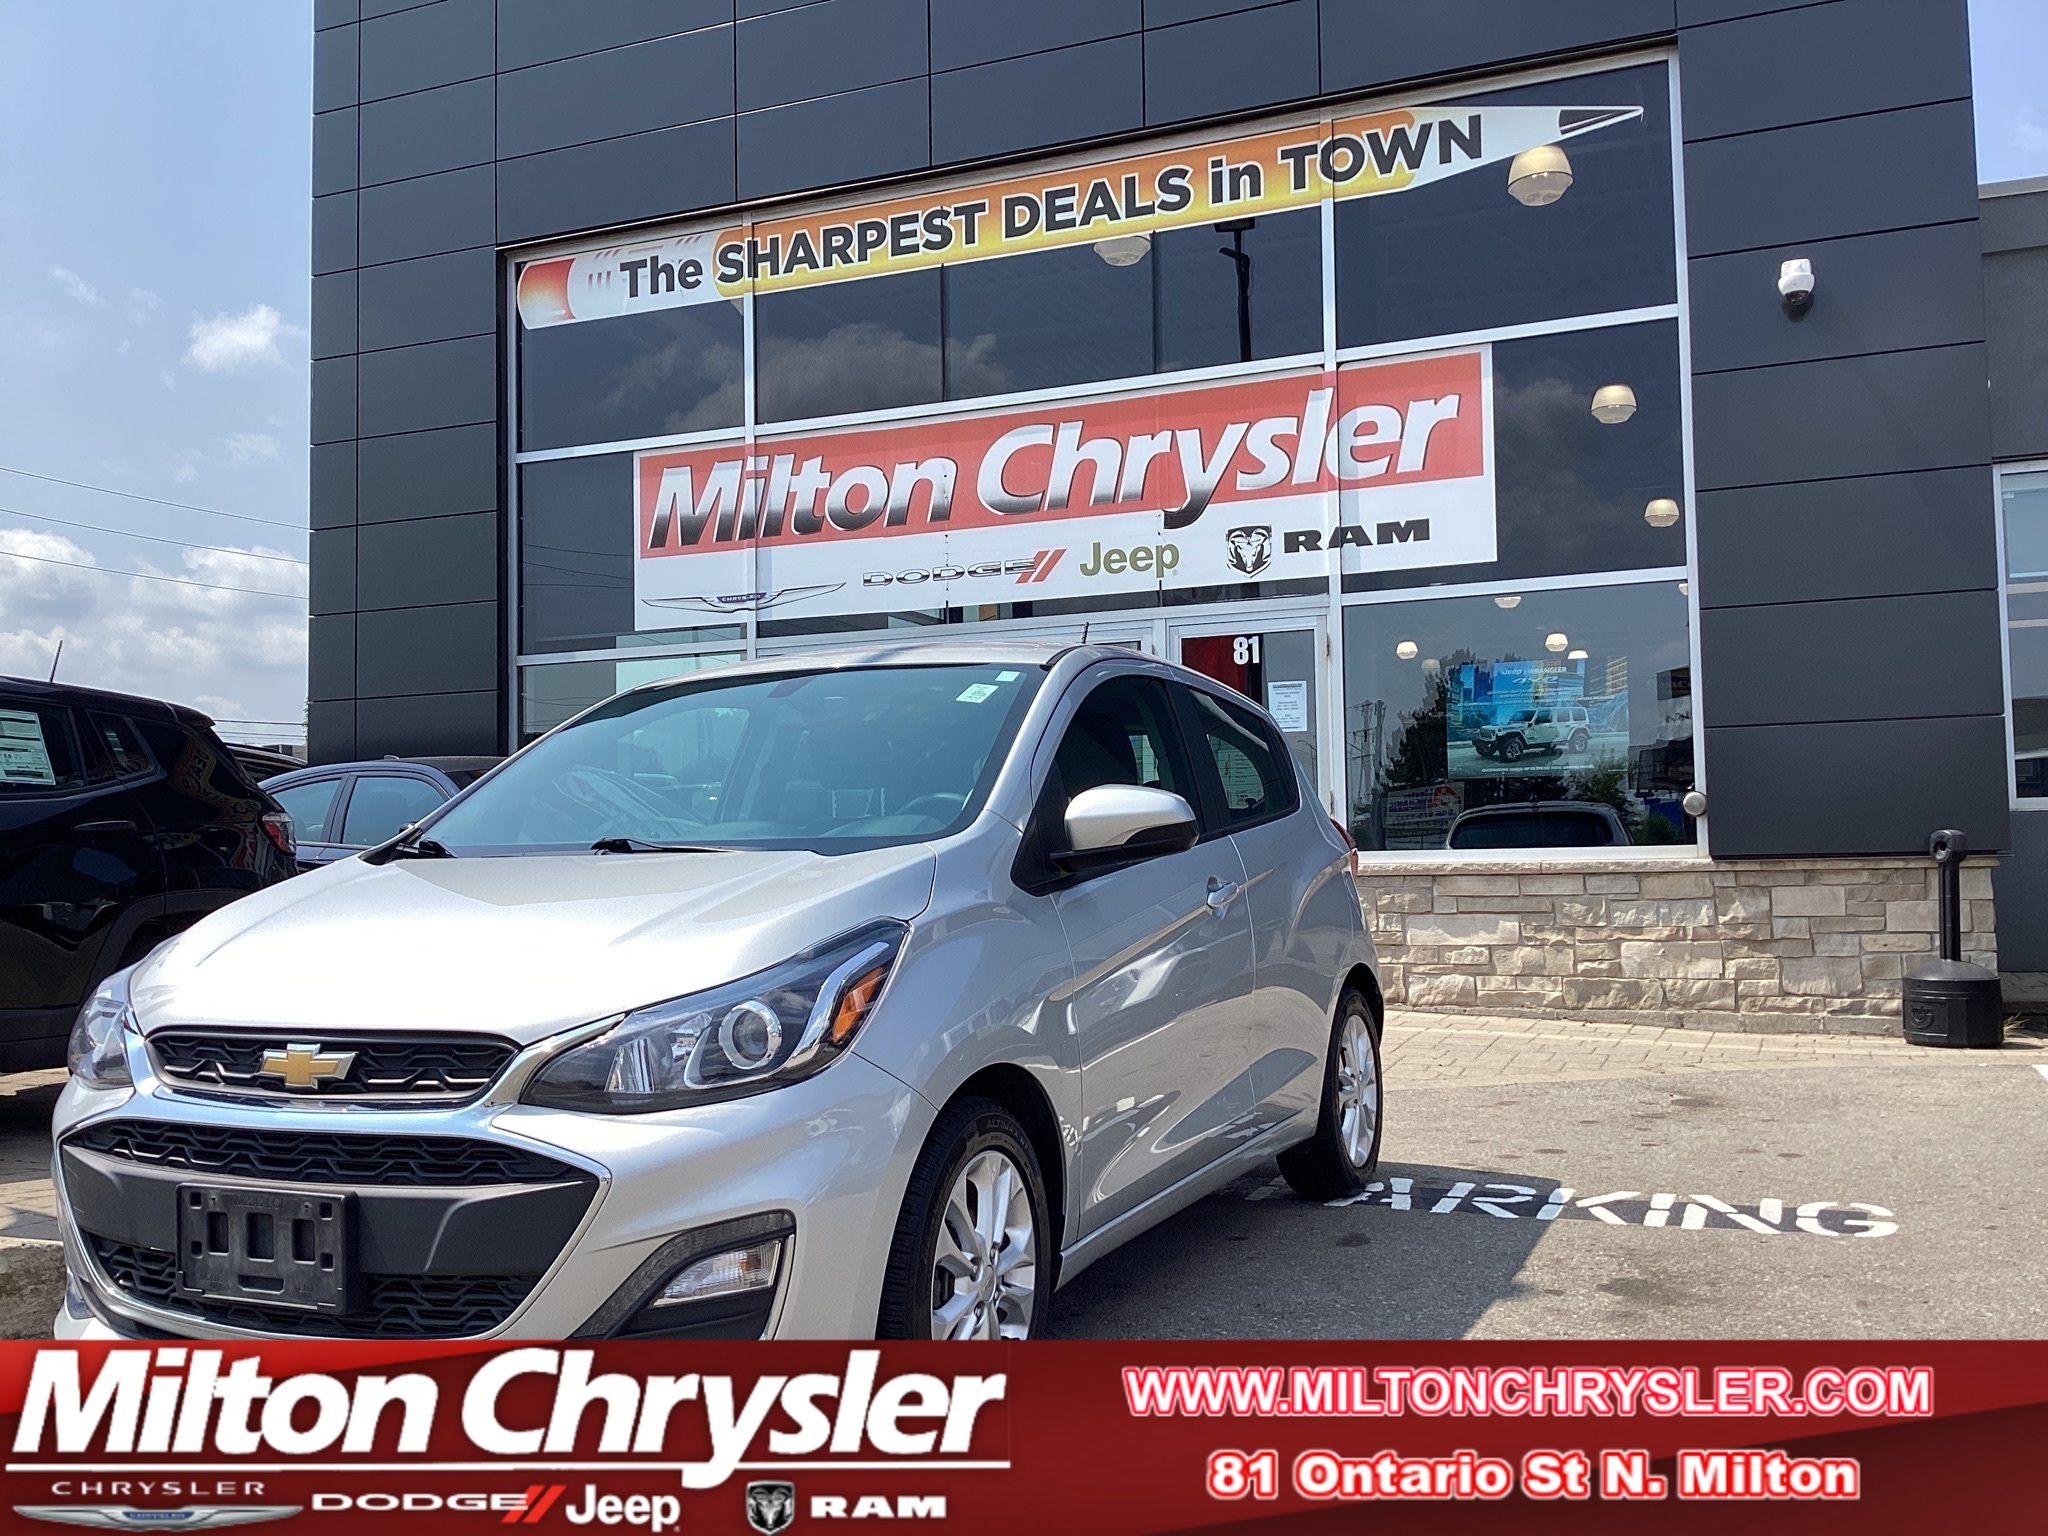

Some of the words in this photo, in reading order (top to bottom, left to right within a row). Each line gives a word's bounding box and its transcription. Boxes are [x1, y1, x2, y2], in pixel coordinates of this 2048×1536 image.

[619, 254, 703, 298] The
[716, 200, 988, 283] SHARPEST
[1003, 166, 1193, 238] DEALS
[1210, 158, 1262, 204] in
[1280, 114, 1483, 191] TOWN
[647, 453, 958, 549] Milton
[977, 386, 1461, 530] Chrysler
[1284, 518, 1430, 554] RAM
[863, 558, 1038, 587] DODGE
[1080, 542, 1180, 579] Jeep
[1233, 635, 1260, 665] 81
[1528, 665, 1568, 676] WRANGLER
